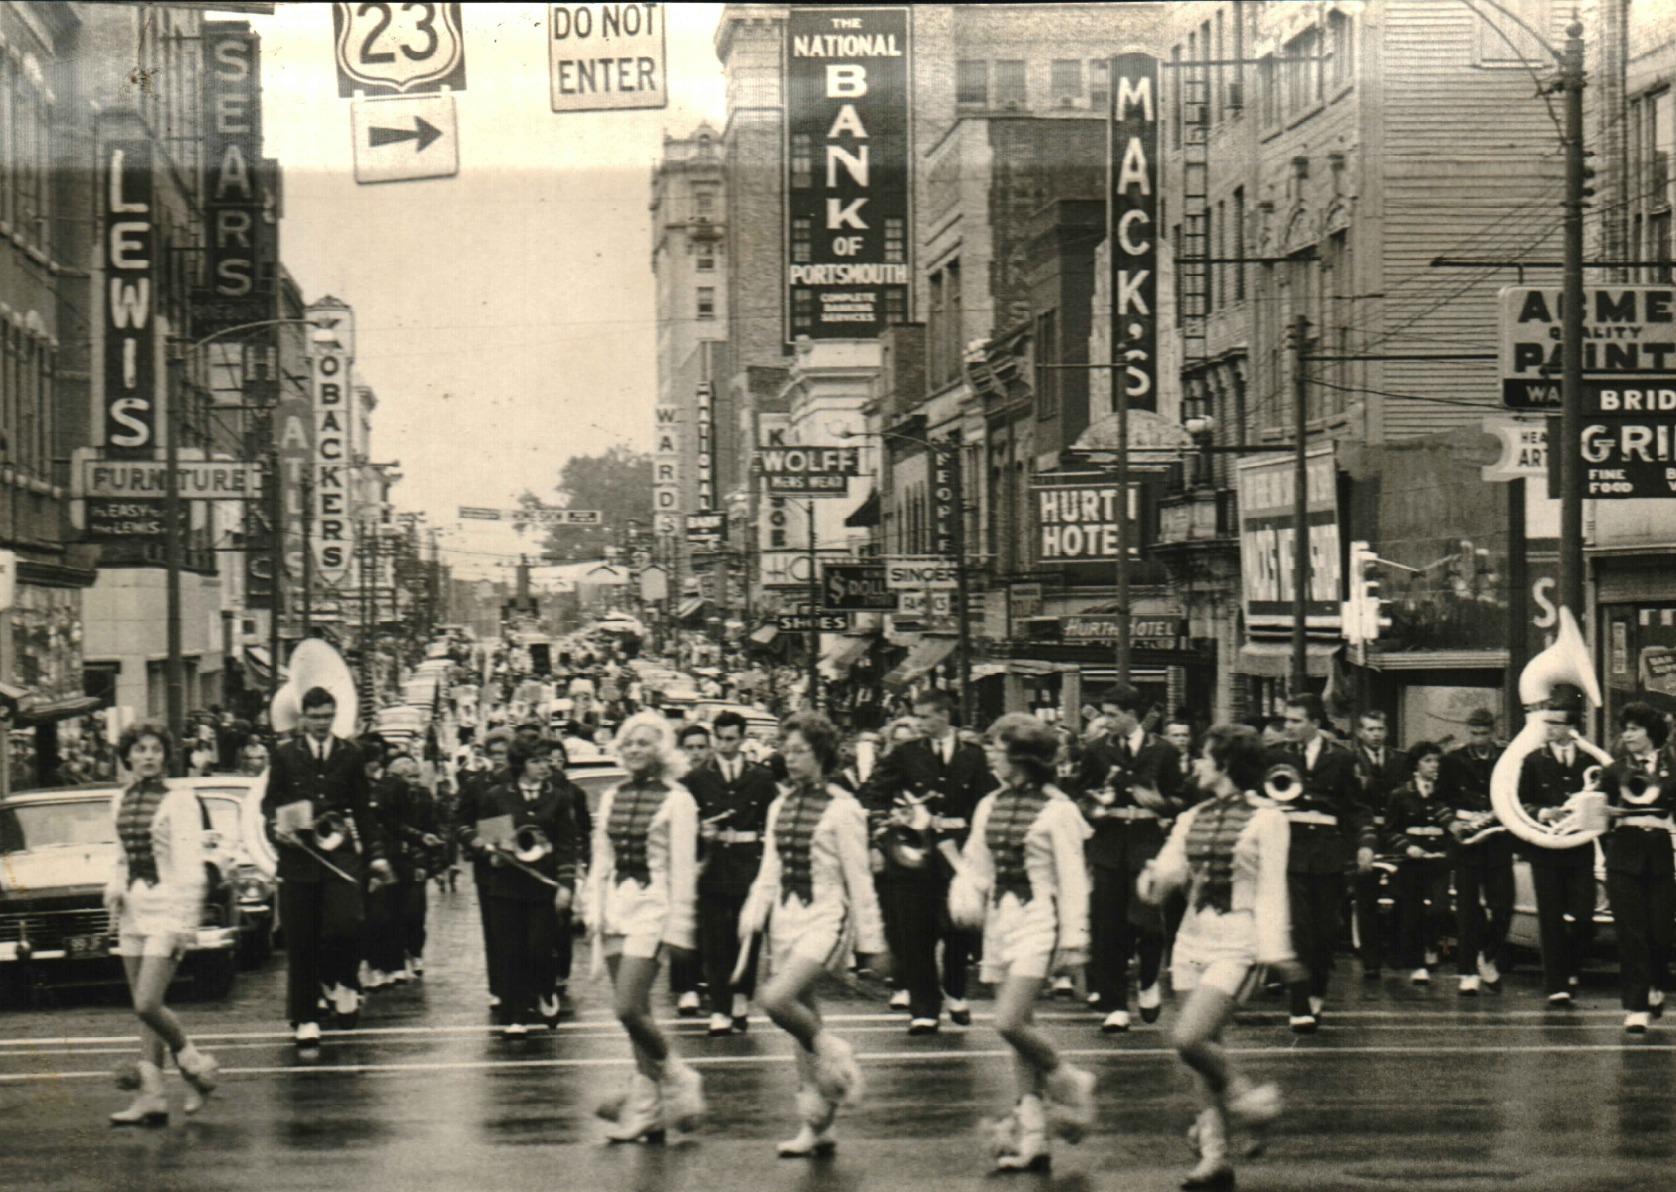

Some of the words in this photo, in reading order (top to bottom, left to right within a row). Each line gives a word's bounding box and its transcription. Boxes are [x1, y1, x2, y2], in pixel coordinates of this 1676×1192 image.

[360, 3, 439, 63] 23
[554, 6, 592, 40] DO
[602, 3, 657, 38] NOT
[831, 18, 862, 28] THE
[794, 34, 901, 57] NATIONAL
[559, 57, 656, 94] ENTER
[826, 64, 868, 229] BANK
[217, 39, 252, 297] SEARS
[833, 236, 863, 256] OF
[1116, 77, 1153, 396] MACK'S
[790, 263, 907, 284] PORTSMOUTH
[110, 149, 149, 446] LEWIS
[1549, 327, 1643, 340] QALITY
[318, 328, 347, 568] OBACKERS
[1580, 425, 1676, 462] GRI
[656, 407, 676, 536] WARDS
[763, 450, 853, 472] WOLFF
[1588, 469, 1626, 480] FINE
[91, 467, 246, 491] FURNTURE
[1589, 482, 1633, 494] FOOD
[938, 450, 950, 560] PEOPLE
[890, 567, 960, 581] SINGER
[780, 617, 846, 629] SHES
